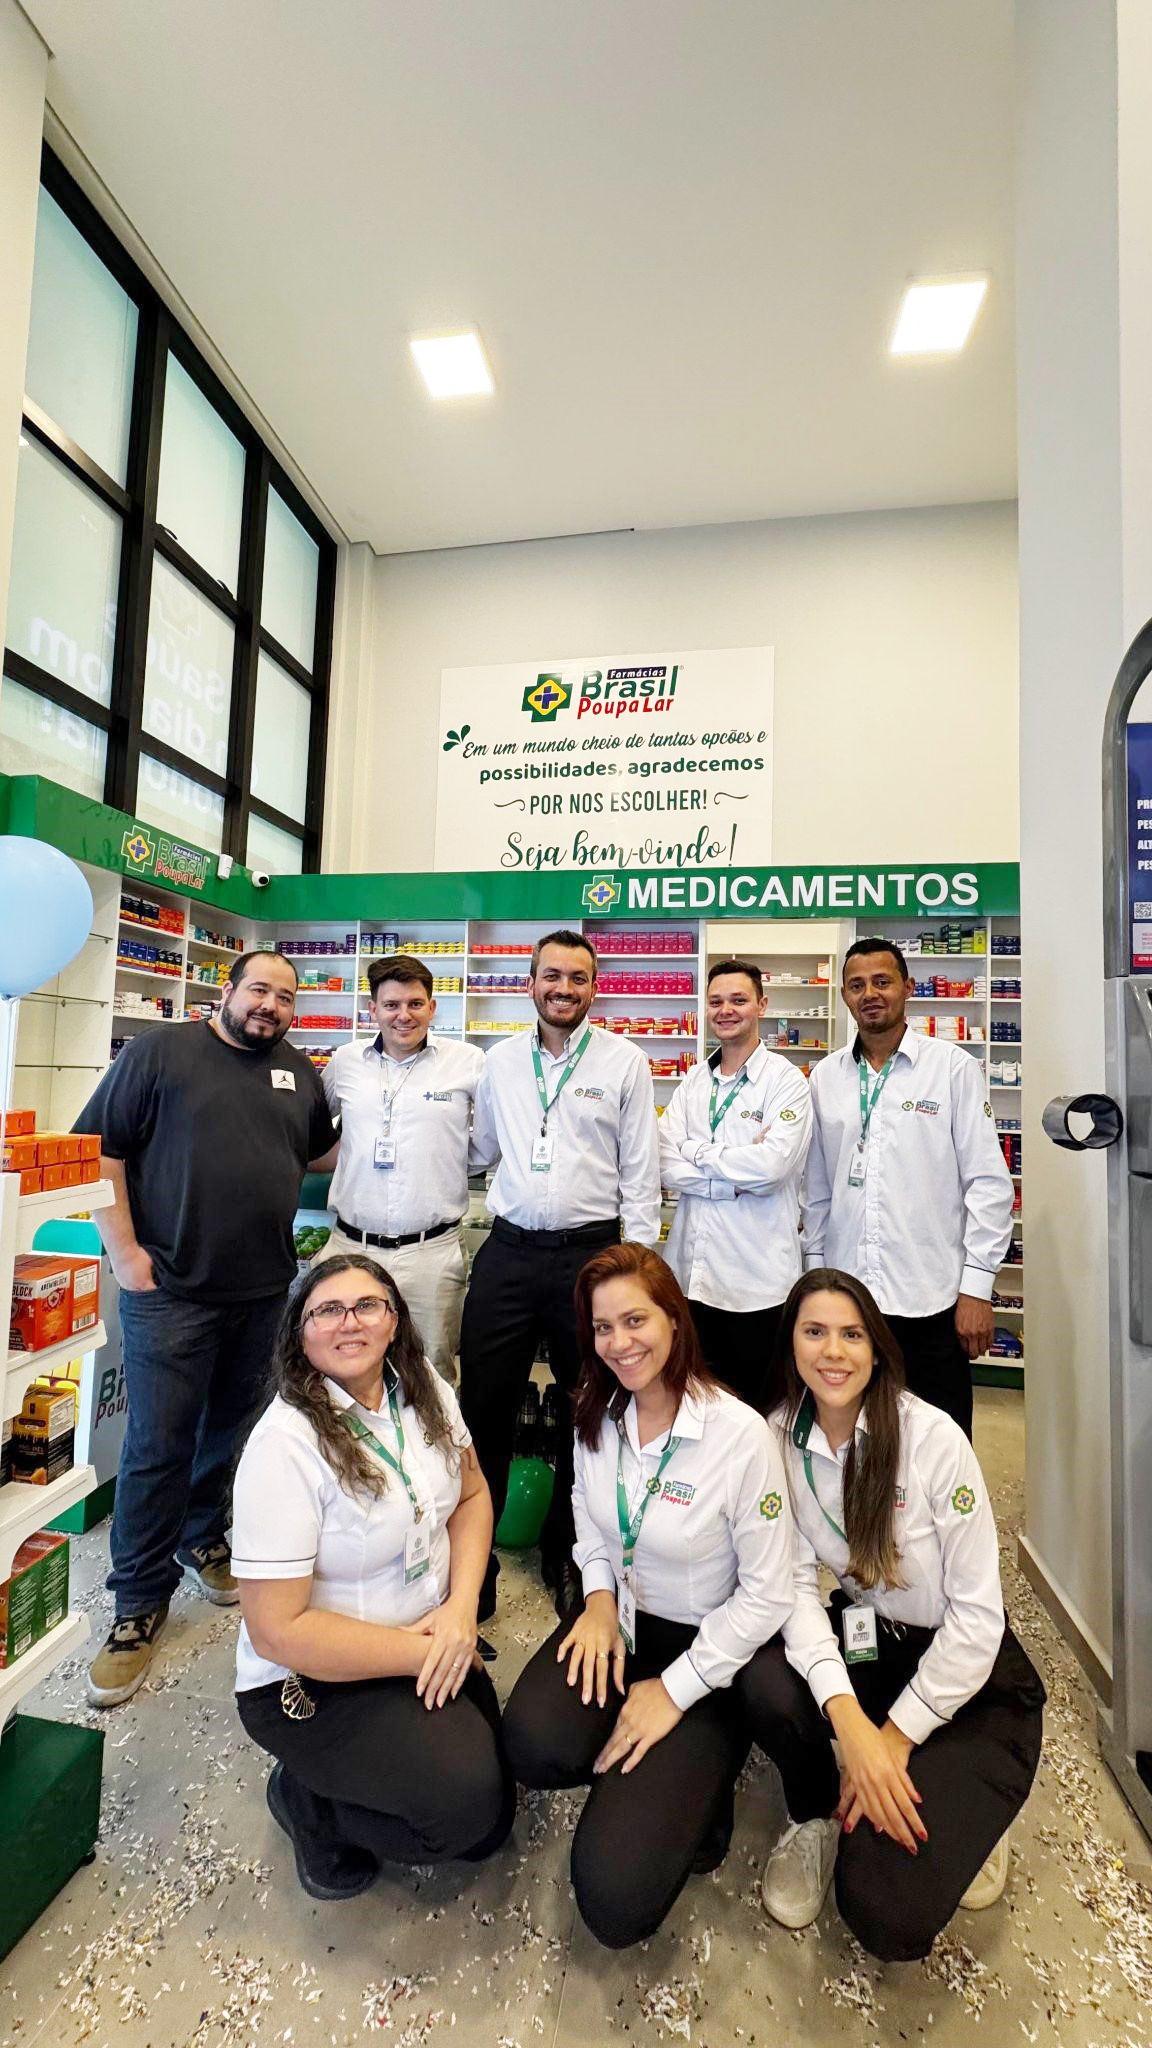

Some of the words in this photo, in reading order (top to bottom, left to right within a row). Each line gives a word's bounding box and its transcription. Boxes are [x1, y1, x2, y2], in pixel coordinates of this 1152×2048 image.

[581, 665, 679, 699] Brasil
[610, 668, 665, 680] Farmácias
[463, 741, 488, 758] Em
[493, 743, 518, 755] um
[523, 737, 577, 754] mundo
[582, 734, 622, 751] cheio
[625, 733, 646, 748] de
[648, 732, 698, 747] tantas
[757, 731, 768, 743] e
[480, 761, 623, 785] possibilidades,
[628, 757, 765, 777] agradecemos
[530, 794, 563, 815] POR
[570, 793, 604, 813] NOS
[610, 789, 708, 812] ESCOLHER!
[1138, 820, 1152, 830] PES
[157, 837, 208, 880] Brasil
[500, 832, 568, 870] Seja
[1138, 860, 1152, 870] PES
[628, 872, 979, 908] MEDICAMENTOS
[12, 1285, 33, 1298] BLOCK
[663, 1480, 696, 1500] Brasil
